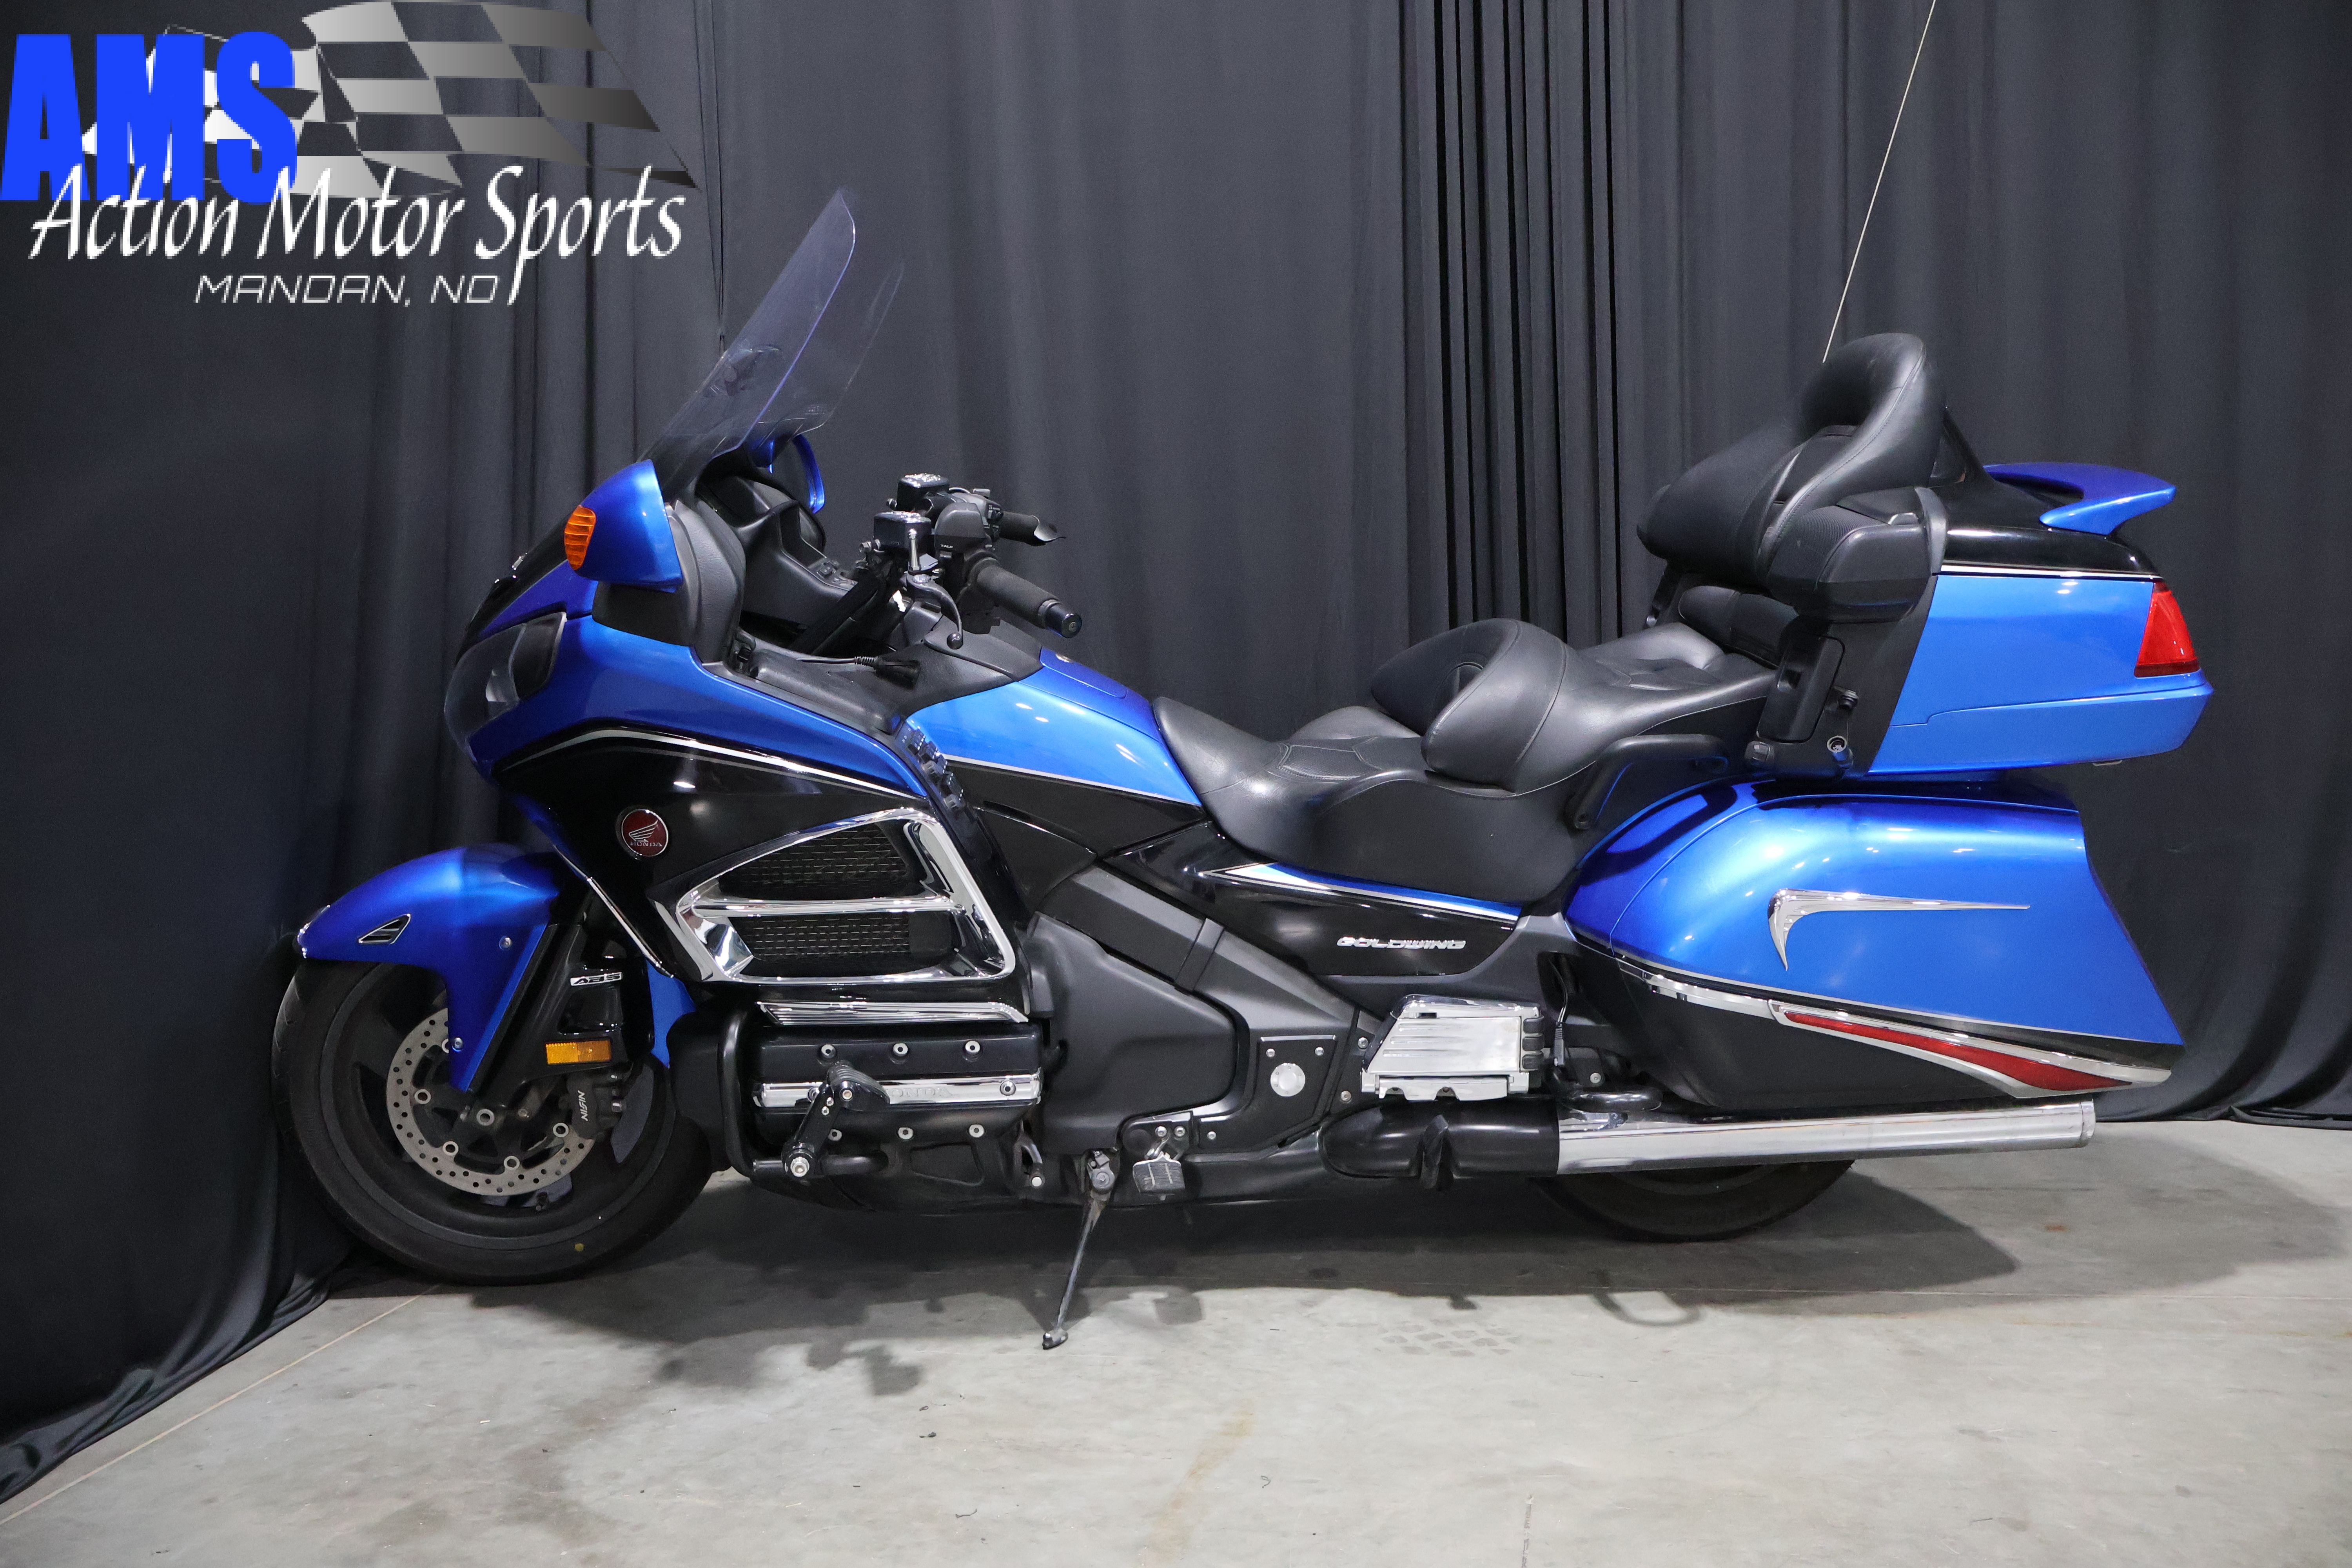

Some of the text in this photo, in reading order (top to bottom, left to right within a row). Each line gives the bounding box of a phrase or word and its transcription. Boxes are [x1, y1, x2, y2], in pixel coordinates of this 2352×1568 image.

[1337, 936, 1466, 949] GOLDWING
[572, 973, 622, 985] ABS
[887, 1087, 953, 1098] ONDA
